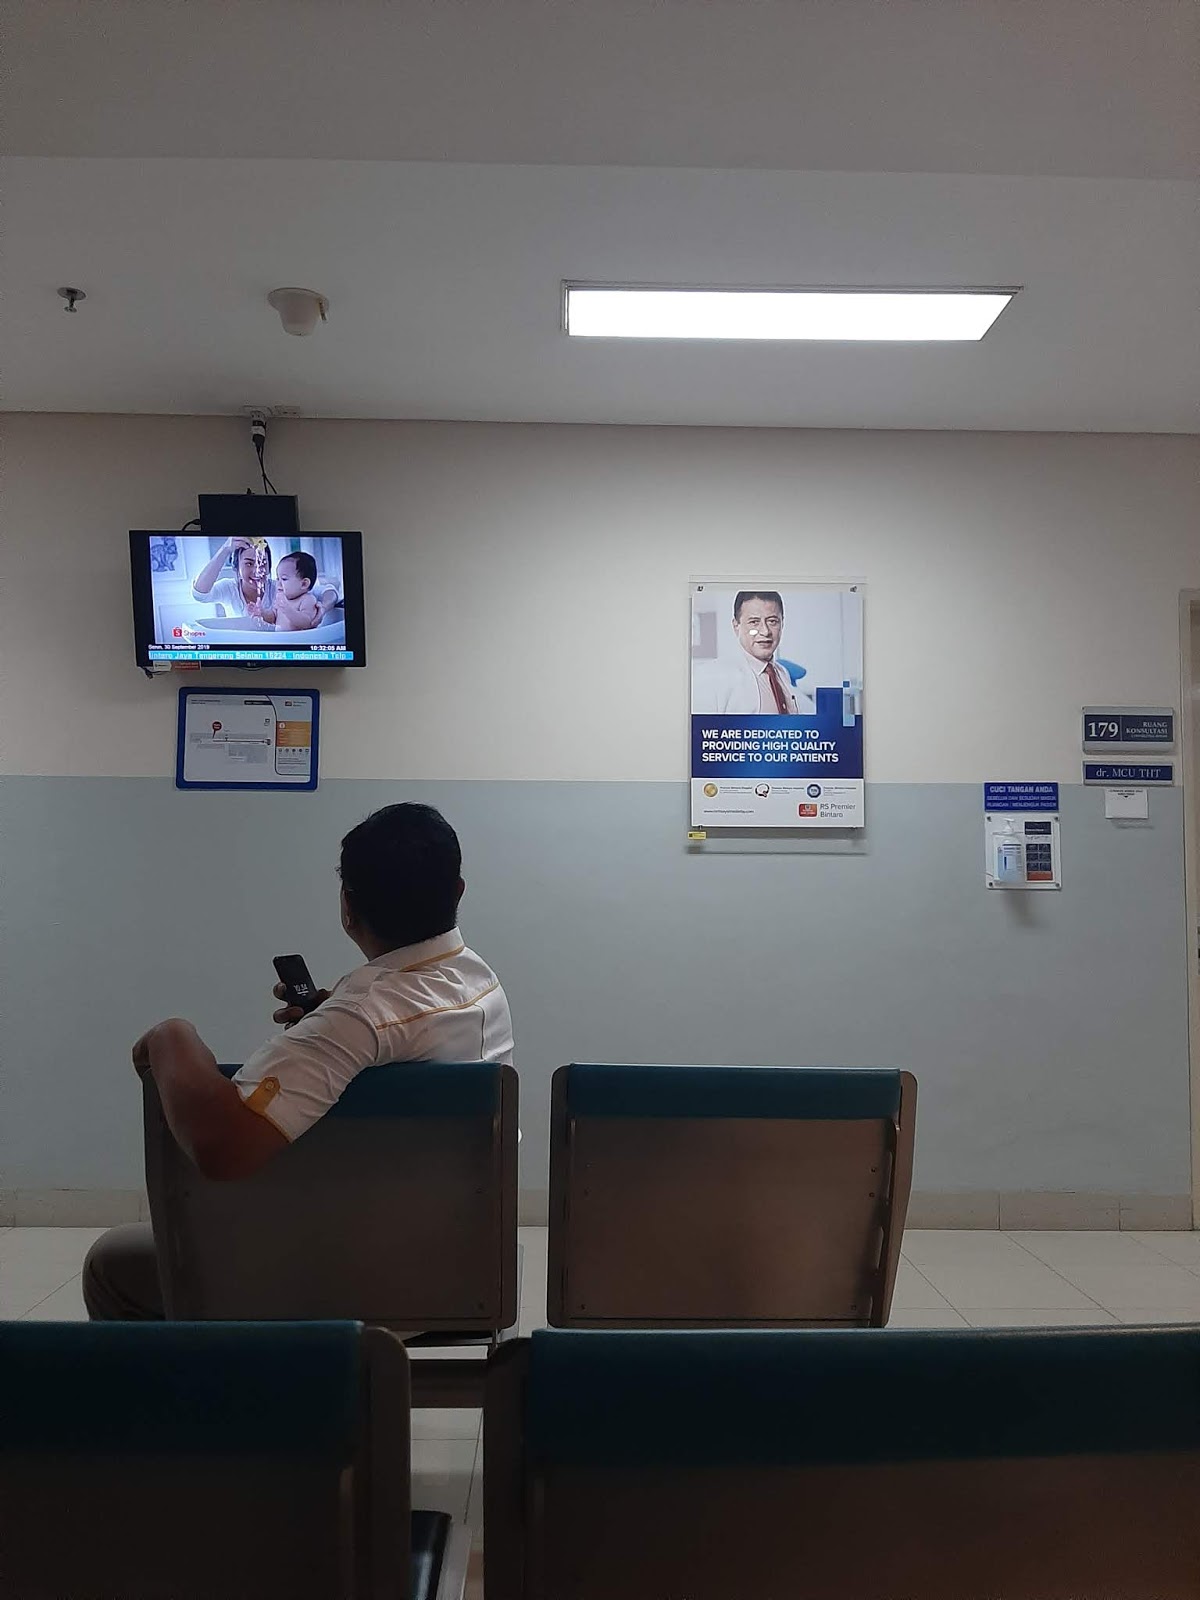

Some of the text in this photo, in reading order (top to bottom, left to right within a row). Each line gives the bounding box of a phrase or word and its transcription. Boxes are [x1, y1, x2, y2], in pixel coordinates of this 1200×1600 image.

[702, 729, 819, 739] WE ARE DEDICATED TO
[1088, 722, 1119, 738] 179
[702, 741, 836, 751] PROVIDING HIGH QUALITY
[702, 753, 839, 763] SERVICE TO OUR PATIENTS
[1096, 768, 1109, 777] dr.
[1112, 769, 1136, 777] MCU
